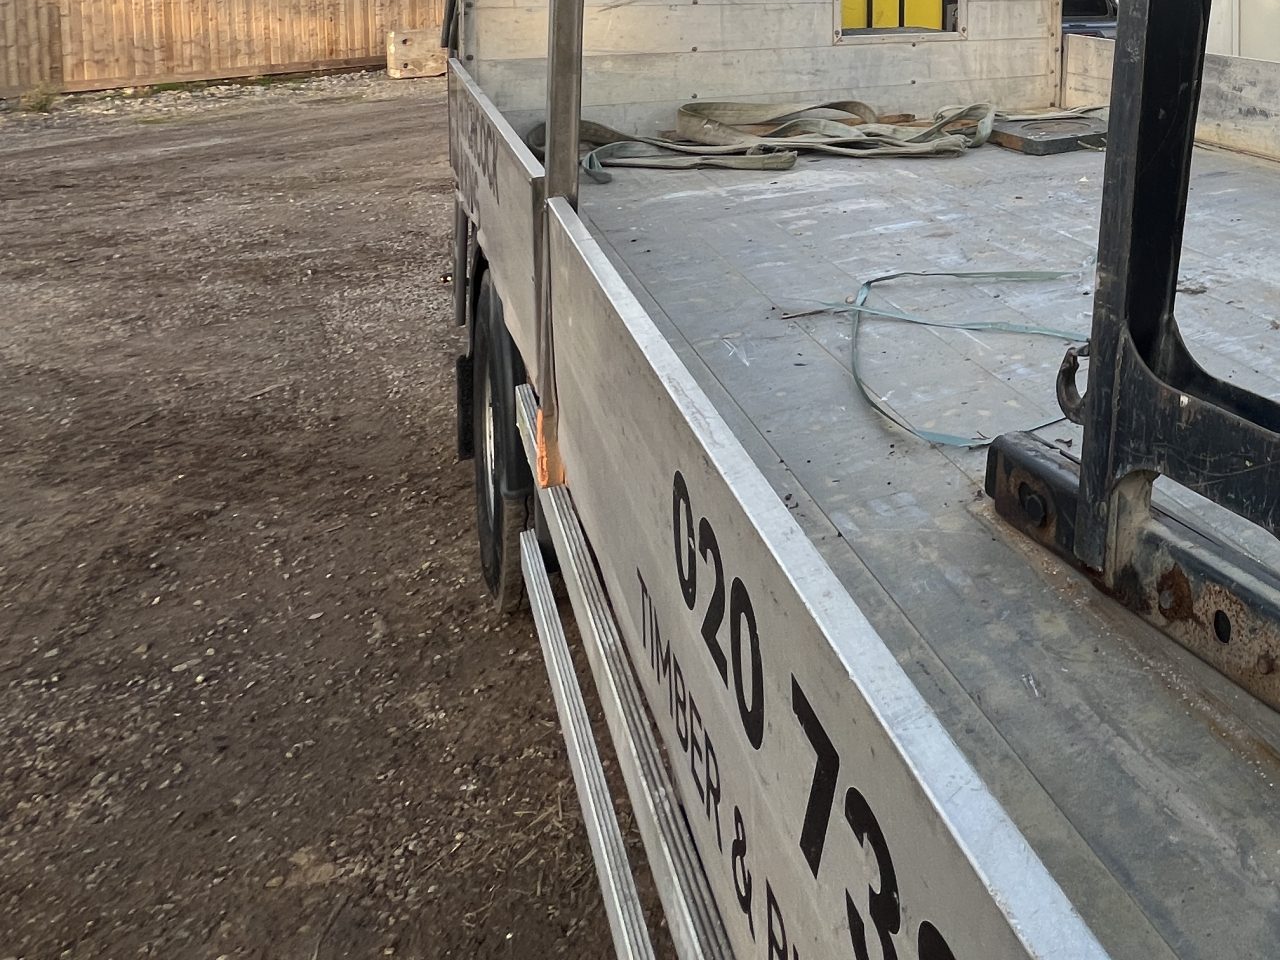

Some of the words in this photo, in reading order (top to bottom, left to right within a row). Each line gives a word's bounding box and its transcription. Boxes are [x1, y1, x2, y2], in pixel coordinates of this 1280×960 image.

[636, 566, 723, 854] TIMBER
[731, 804, 756, 945] &
[673, 470, 764, 751] 020
